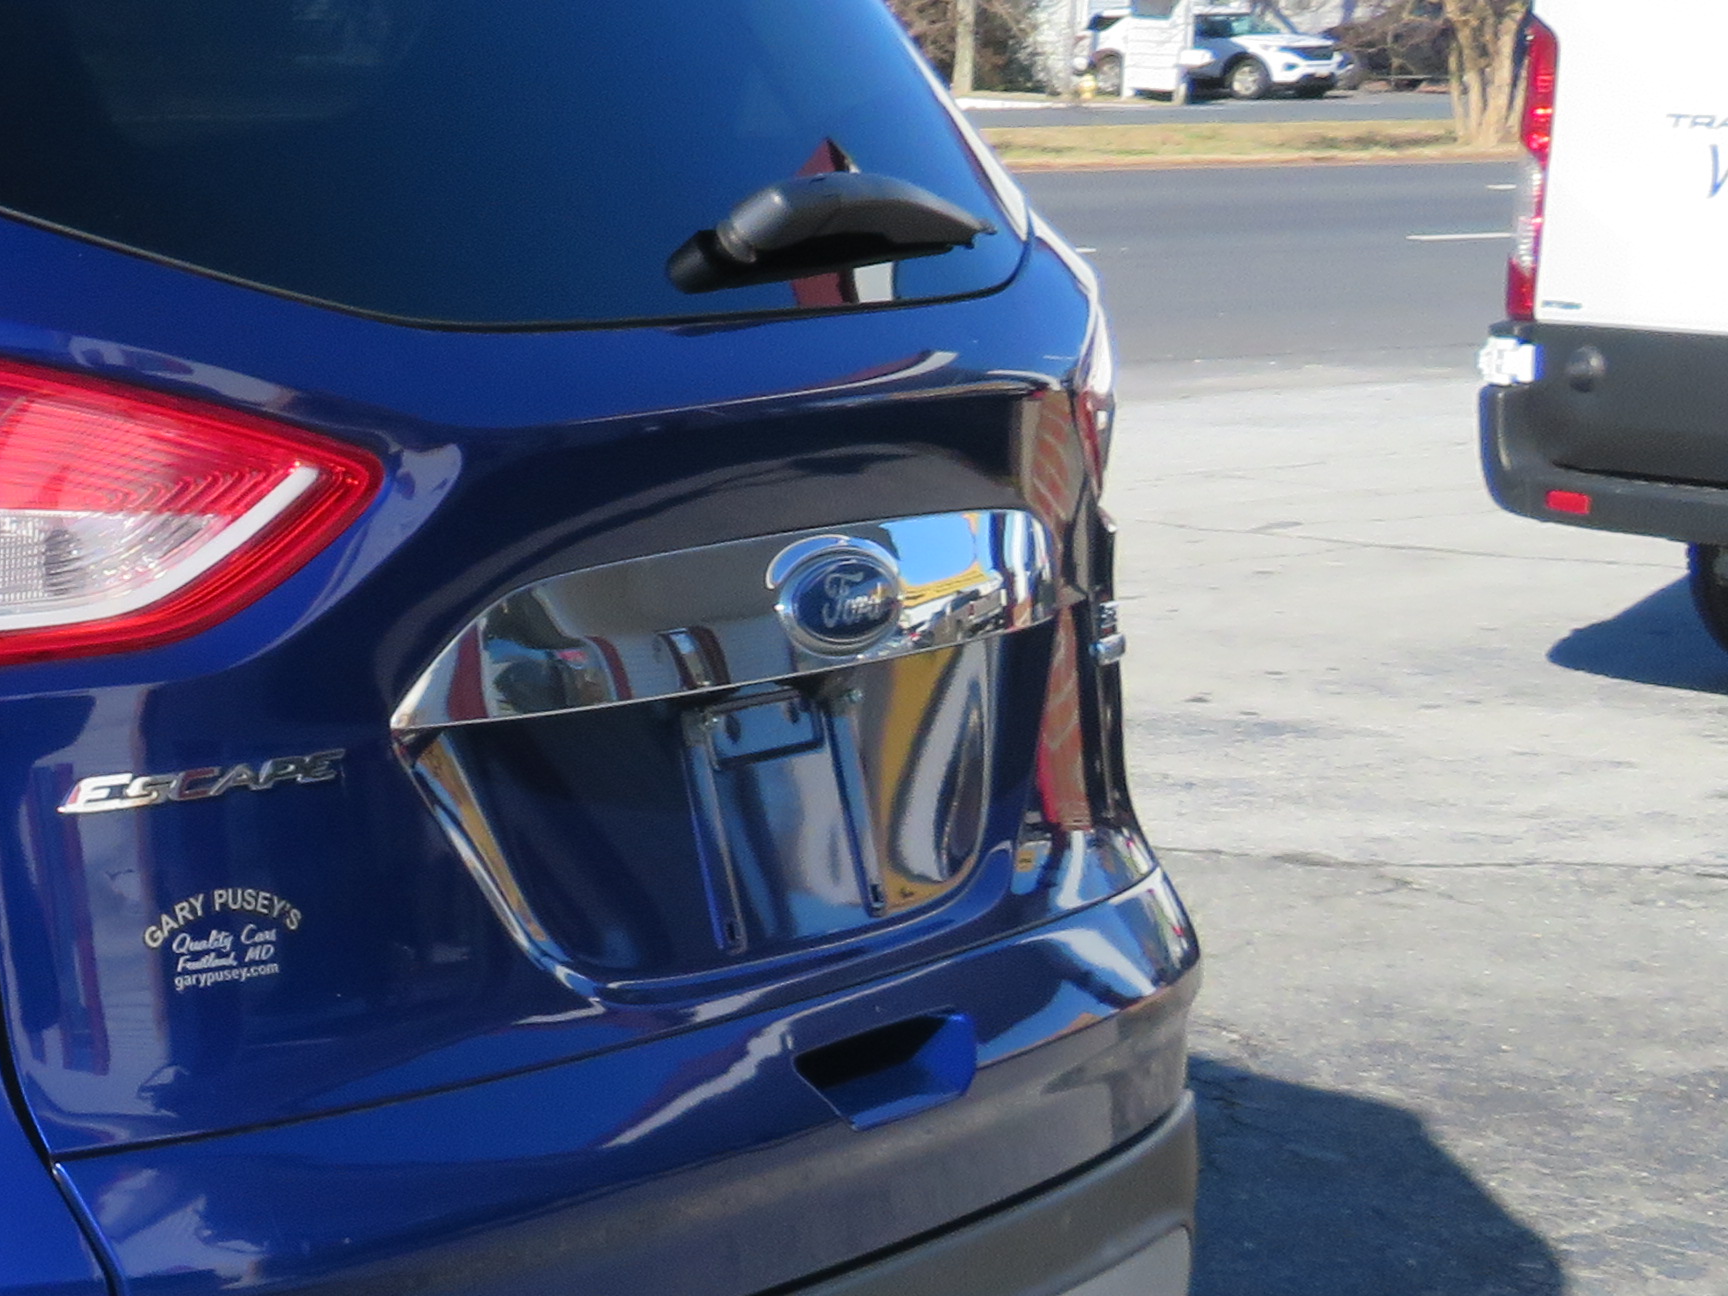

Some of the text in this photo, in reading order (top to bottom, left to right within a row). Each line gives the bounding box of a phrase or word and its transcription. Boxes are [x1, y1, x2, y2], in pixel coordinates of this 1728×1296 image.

[821, 571, 885, 629] Ford
[55, 747, 346, 815] ESCAPE
[144, 887, 302, 949] GARY PUSEY'S
[172, 923, 277, 955] Quality Cars
[244, 944, 275, 963] MD
[174, 962, 280, 992] garypusey.com
